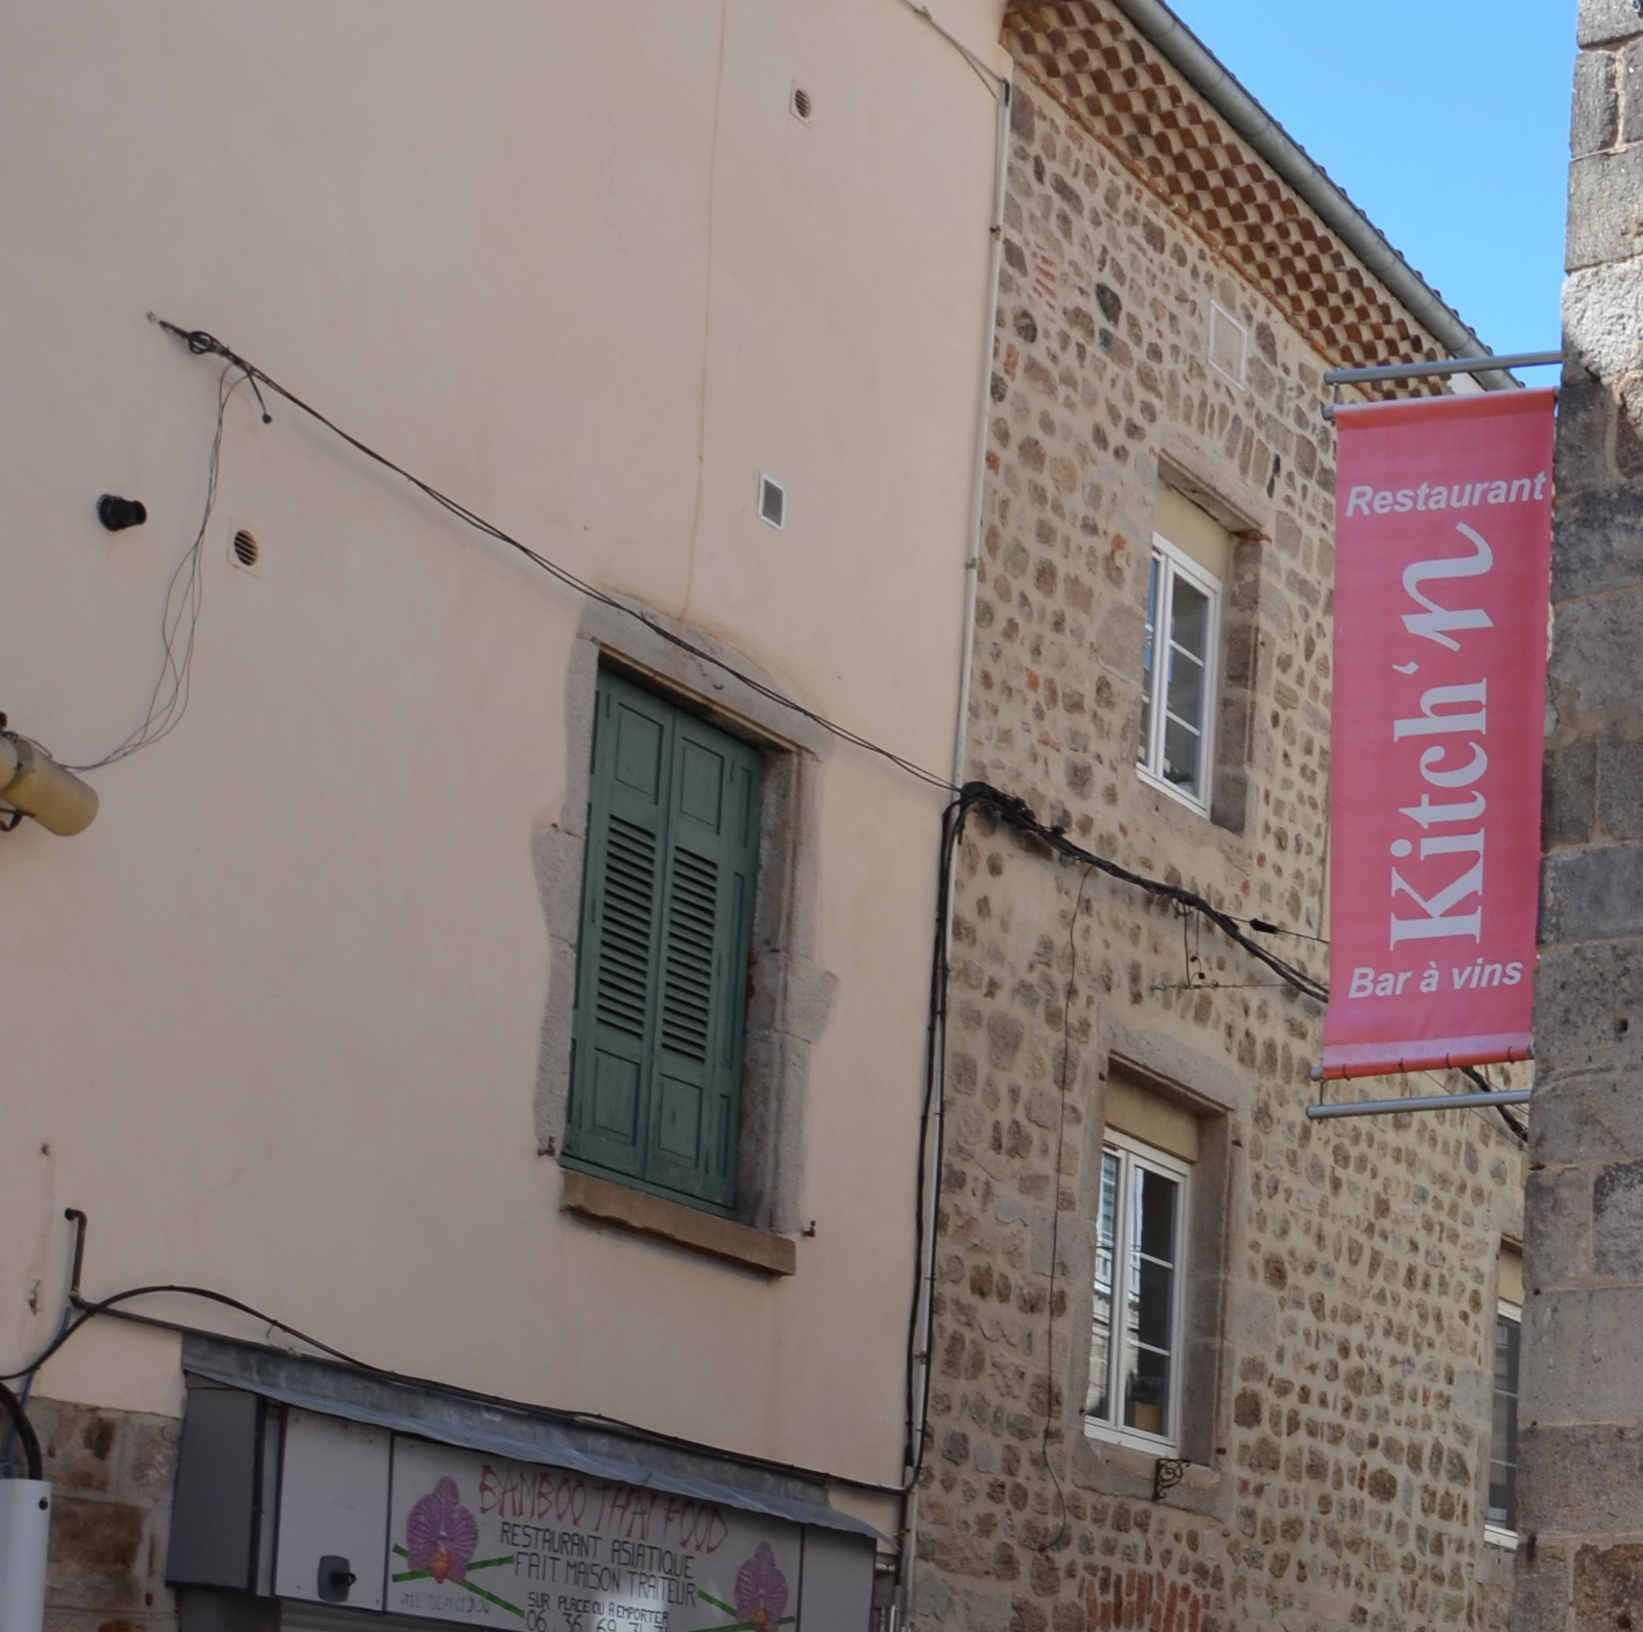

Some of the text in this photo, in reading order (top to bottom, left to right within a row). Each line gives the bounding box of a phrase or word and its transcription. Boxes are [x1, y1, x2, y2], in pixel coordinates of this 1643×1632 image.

[1345, 470, 1546, 517] Restaurant
[1388, 521, 1495, 952] Kitch'n
[1348, 956, 1523, 1000] Bar à vins
[478, 1463, 729, 1555] BAMBOO THAI FOOD
[499, 1521, 696, 1580] RESTAURANT ASIATIQUE
[514, 1551, 697, 1607] FAIT MAISON TRAITEUR
[528, 1591, 550, 1610] SUR
[558, 1595, 590, 1613] PLACE
[591, 1599, 605, 1616] OU
[617, 1605, 670, 1624] EMPORTER
